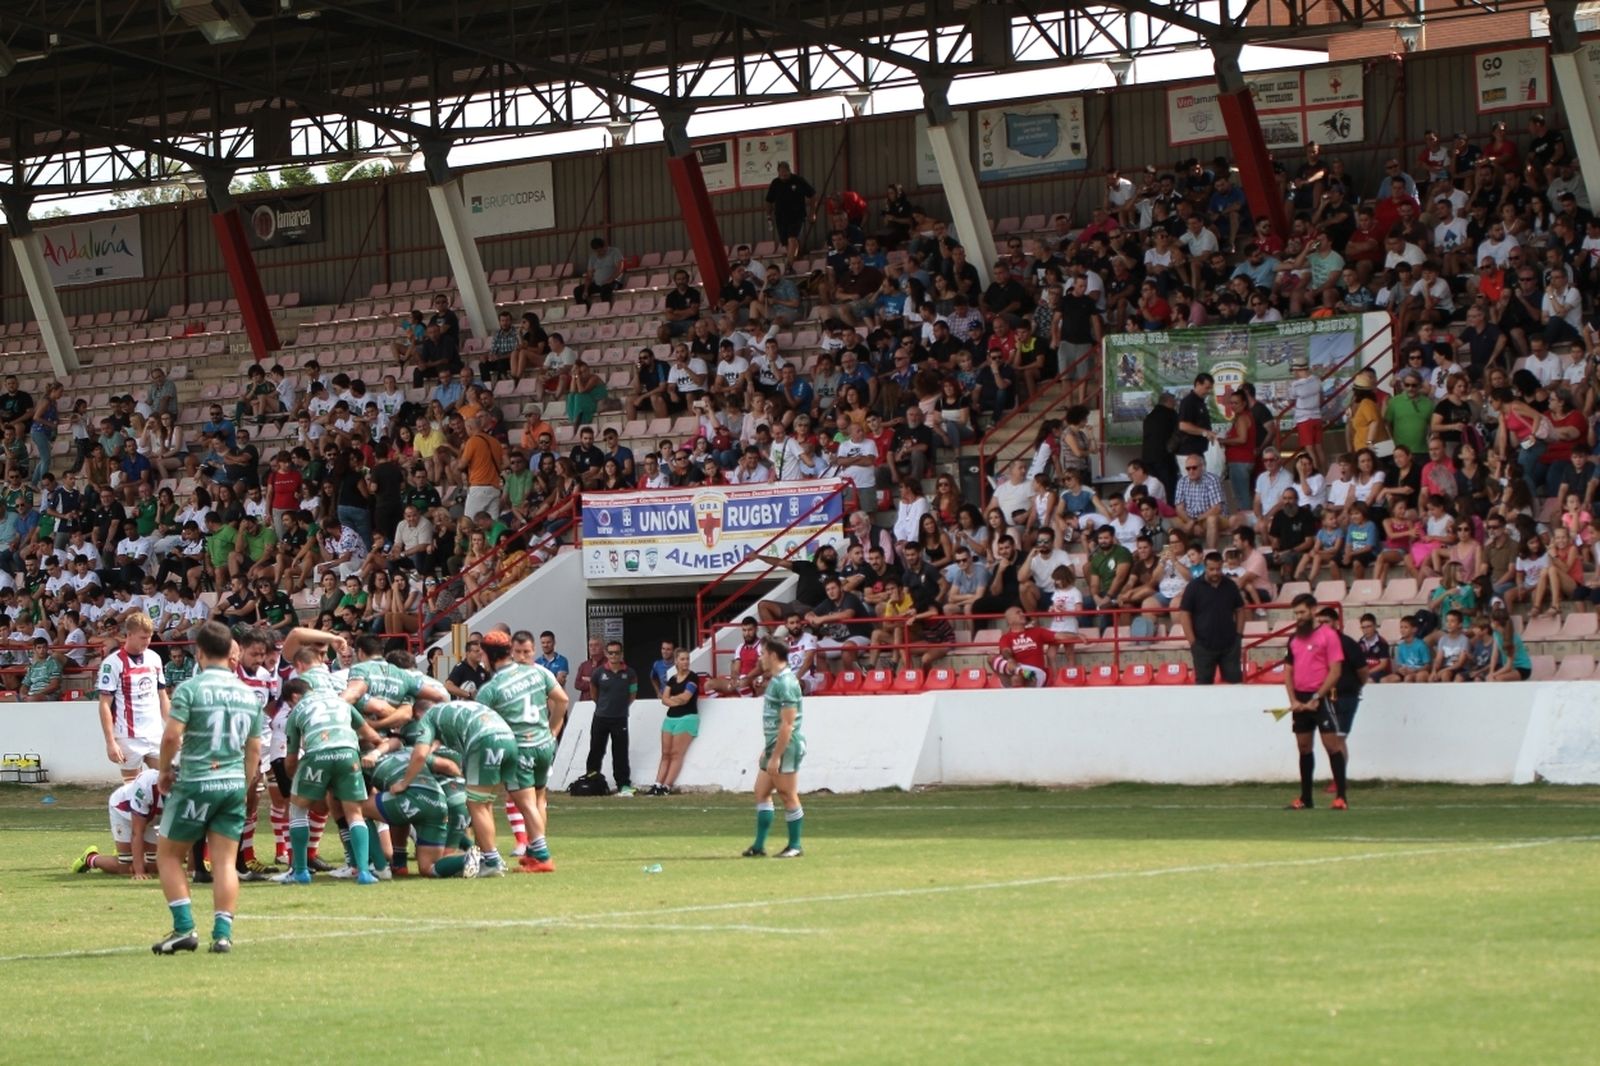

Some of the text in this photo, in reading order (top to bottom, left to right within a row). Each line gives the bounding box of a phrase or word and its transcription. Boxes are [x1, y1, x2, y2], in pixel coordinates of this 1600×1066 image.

[1482, 56, 1502, 71] GO
[639, 505, 690, 532] UNIÓN
[727, 503, 782, 527] RUGBY
[665, 543, 757, 569] ALMERÍA
[523, 693, 540, 724] 6
[207, 710, 252, 752] 10
[484, 747, 506, 765] M
[304, 766, 324, 783] M
[181, 799, 211, 822] M
[400, 798, 421, 819] M
